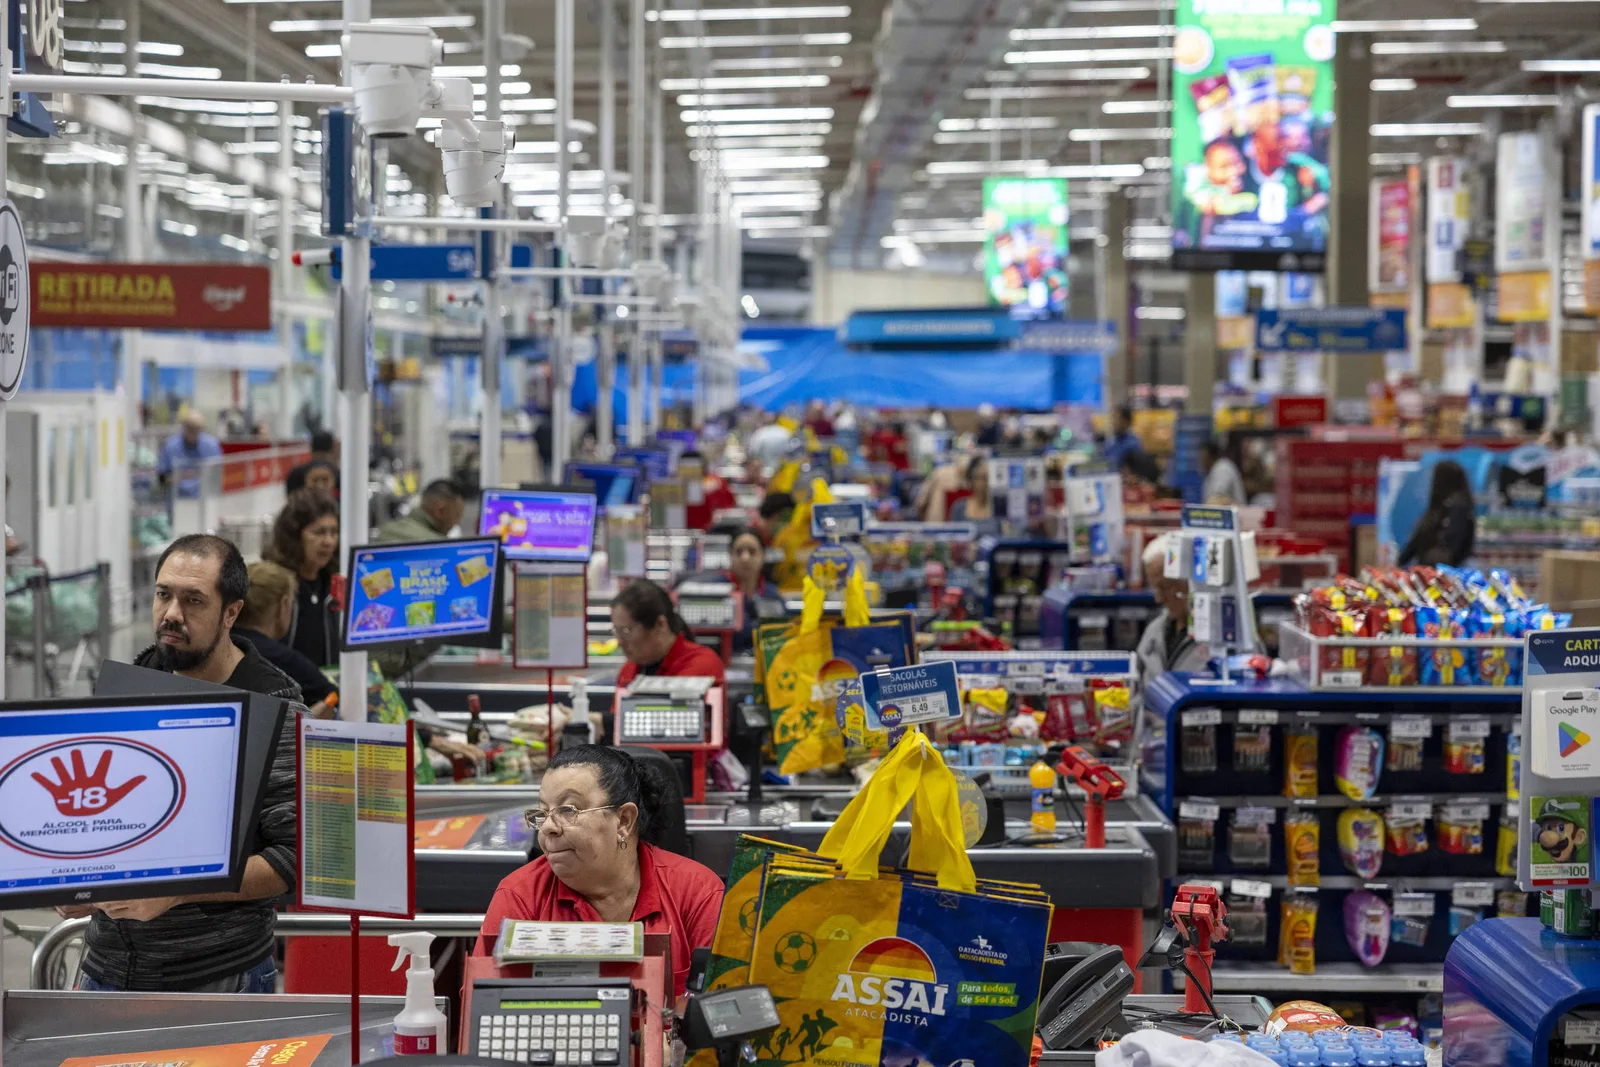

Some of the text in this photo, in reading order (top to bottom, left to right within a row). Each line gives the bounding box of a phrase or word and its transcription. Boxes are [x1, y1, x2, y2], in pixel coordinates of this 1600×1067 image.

[37, 271, 175, 299] RETIRADA
[1565, 639, 1600, 651] CART
[1563, 655, 1600, 667] ADQU
[889, 669, 927, 682] SACOLAS
[882, 678, 938, 694] RETORNÁVEIS
[912, 702, 928, 713] 6,49
[1549, 705, 1597, 716] Google Play
[57, 786, 107, 810] -18
[92, 818, 123, 826] PARA
[19, 827, 79, 838] MENORES
[91, 823, 147, 833] PROIBIDO
[51, 864, 116, 875] CAIXA FECHADO
[75, 891, 92, 900] AOC
[963, 947, 999, 958] ATACADISTA
[961, 983, 981, 993] Para
[961, 994, 973, 1004] de
[974, 995, 989, 1004] Sol
[845, 1008, 929, 1027] ATACADISTA
